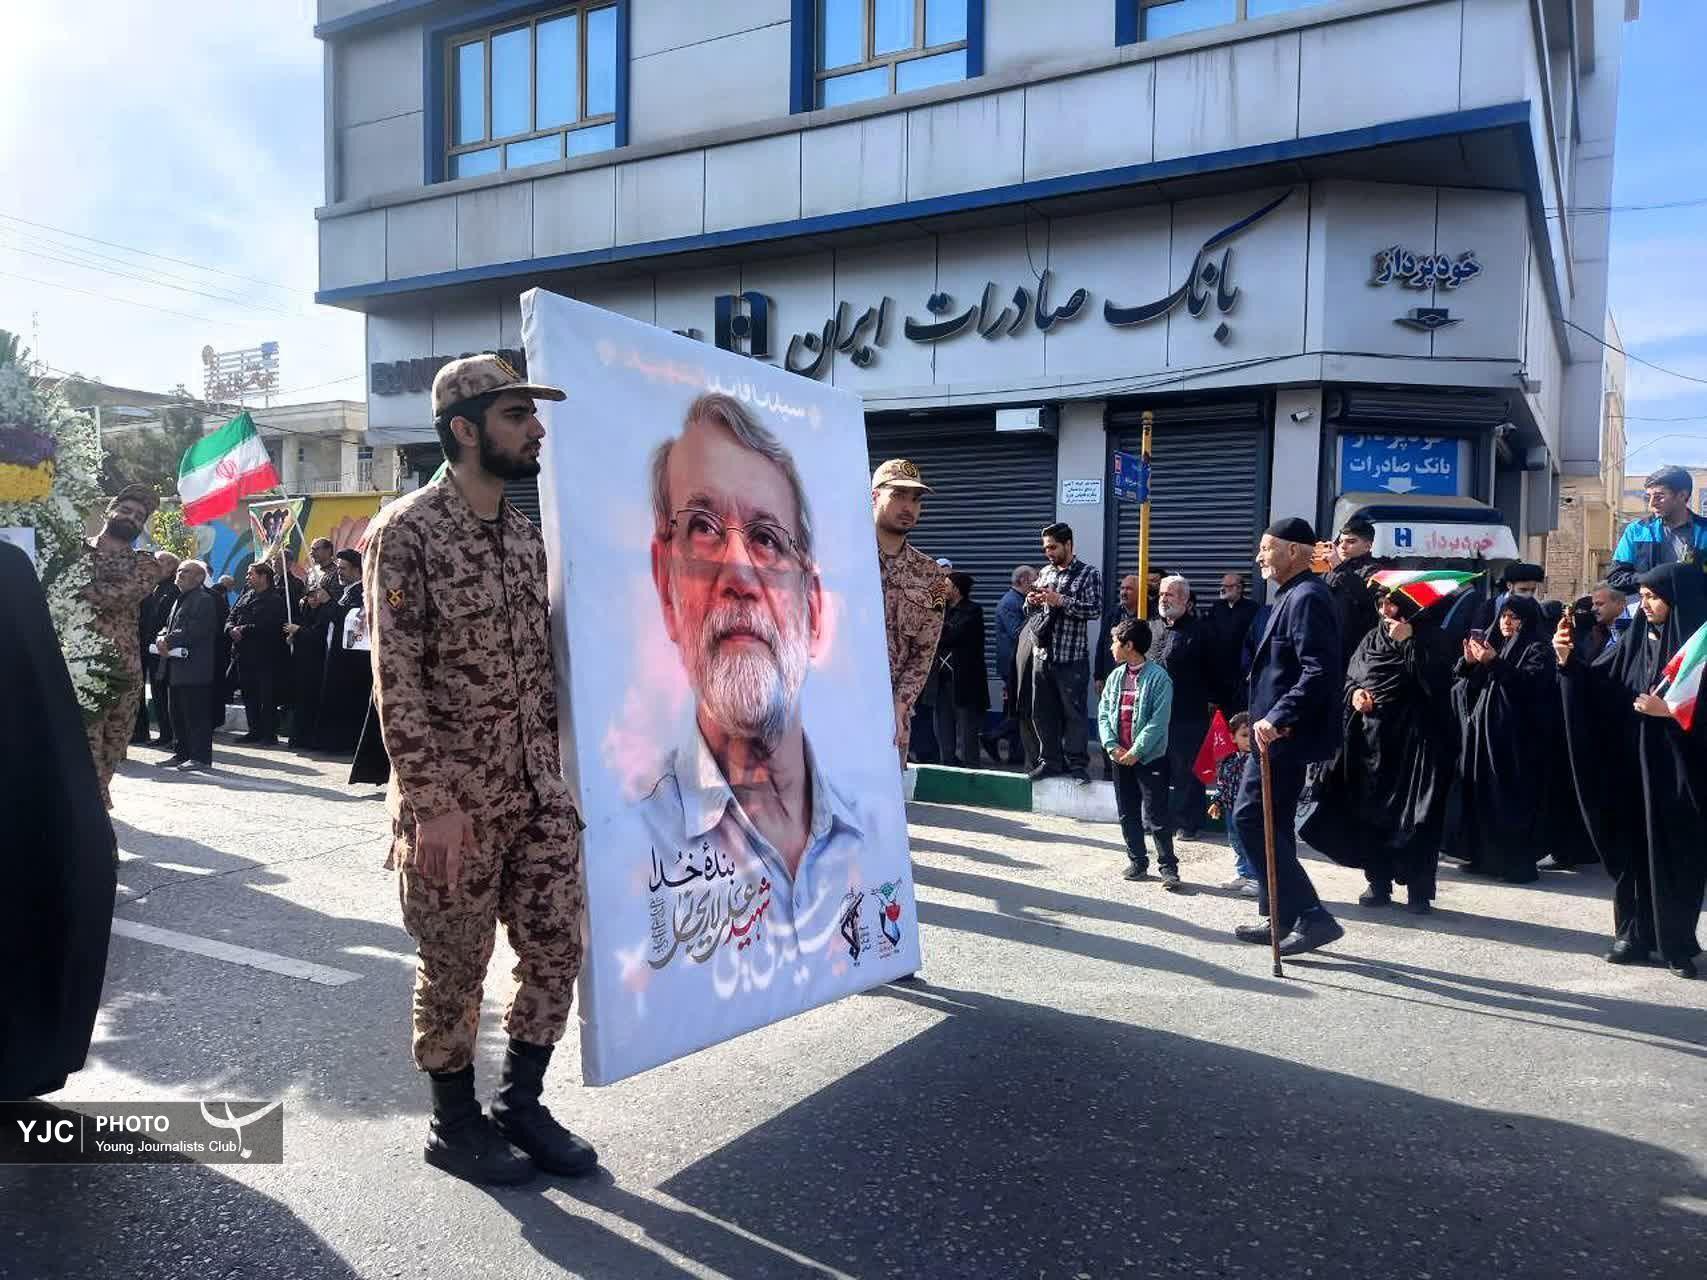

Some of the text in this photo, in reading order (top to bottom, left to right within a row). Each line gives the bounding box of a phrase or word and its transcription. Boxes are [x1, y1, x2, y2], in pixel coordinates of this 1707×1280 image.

[1104, 186, 1296, 345] بانک
[1376, 242, 1481, 289] خودپرداز
[785, 294, 892, 378] ایران
[904, 267, 1091, 342] صادرات
[1349, 455, 1451, 479] بانک صادرات
[690, 883, 757, 964] علی
[725, 876, 772, 951] شهید
